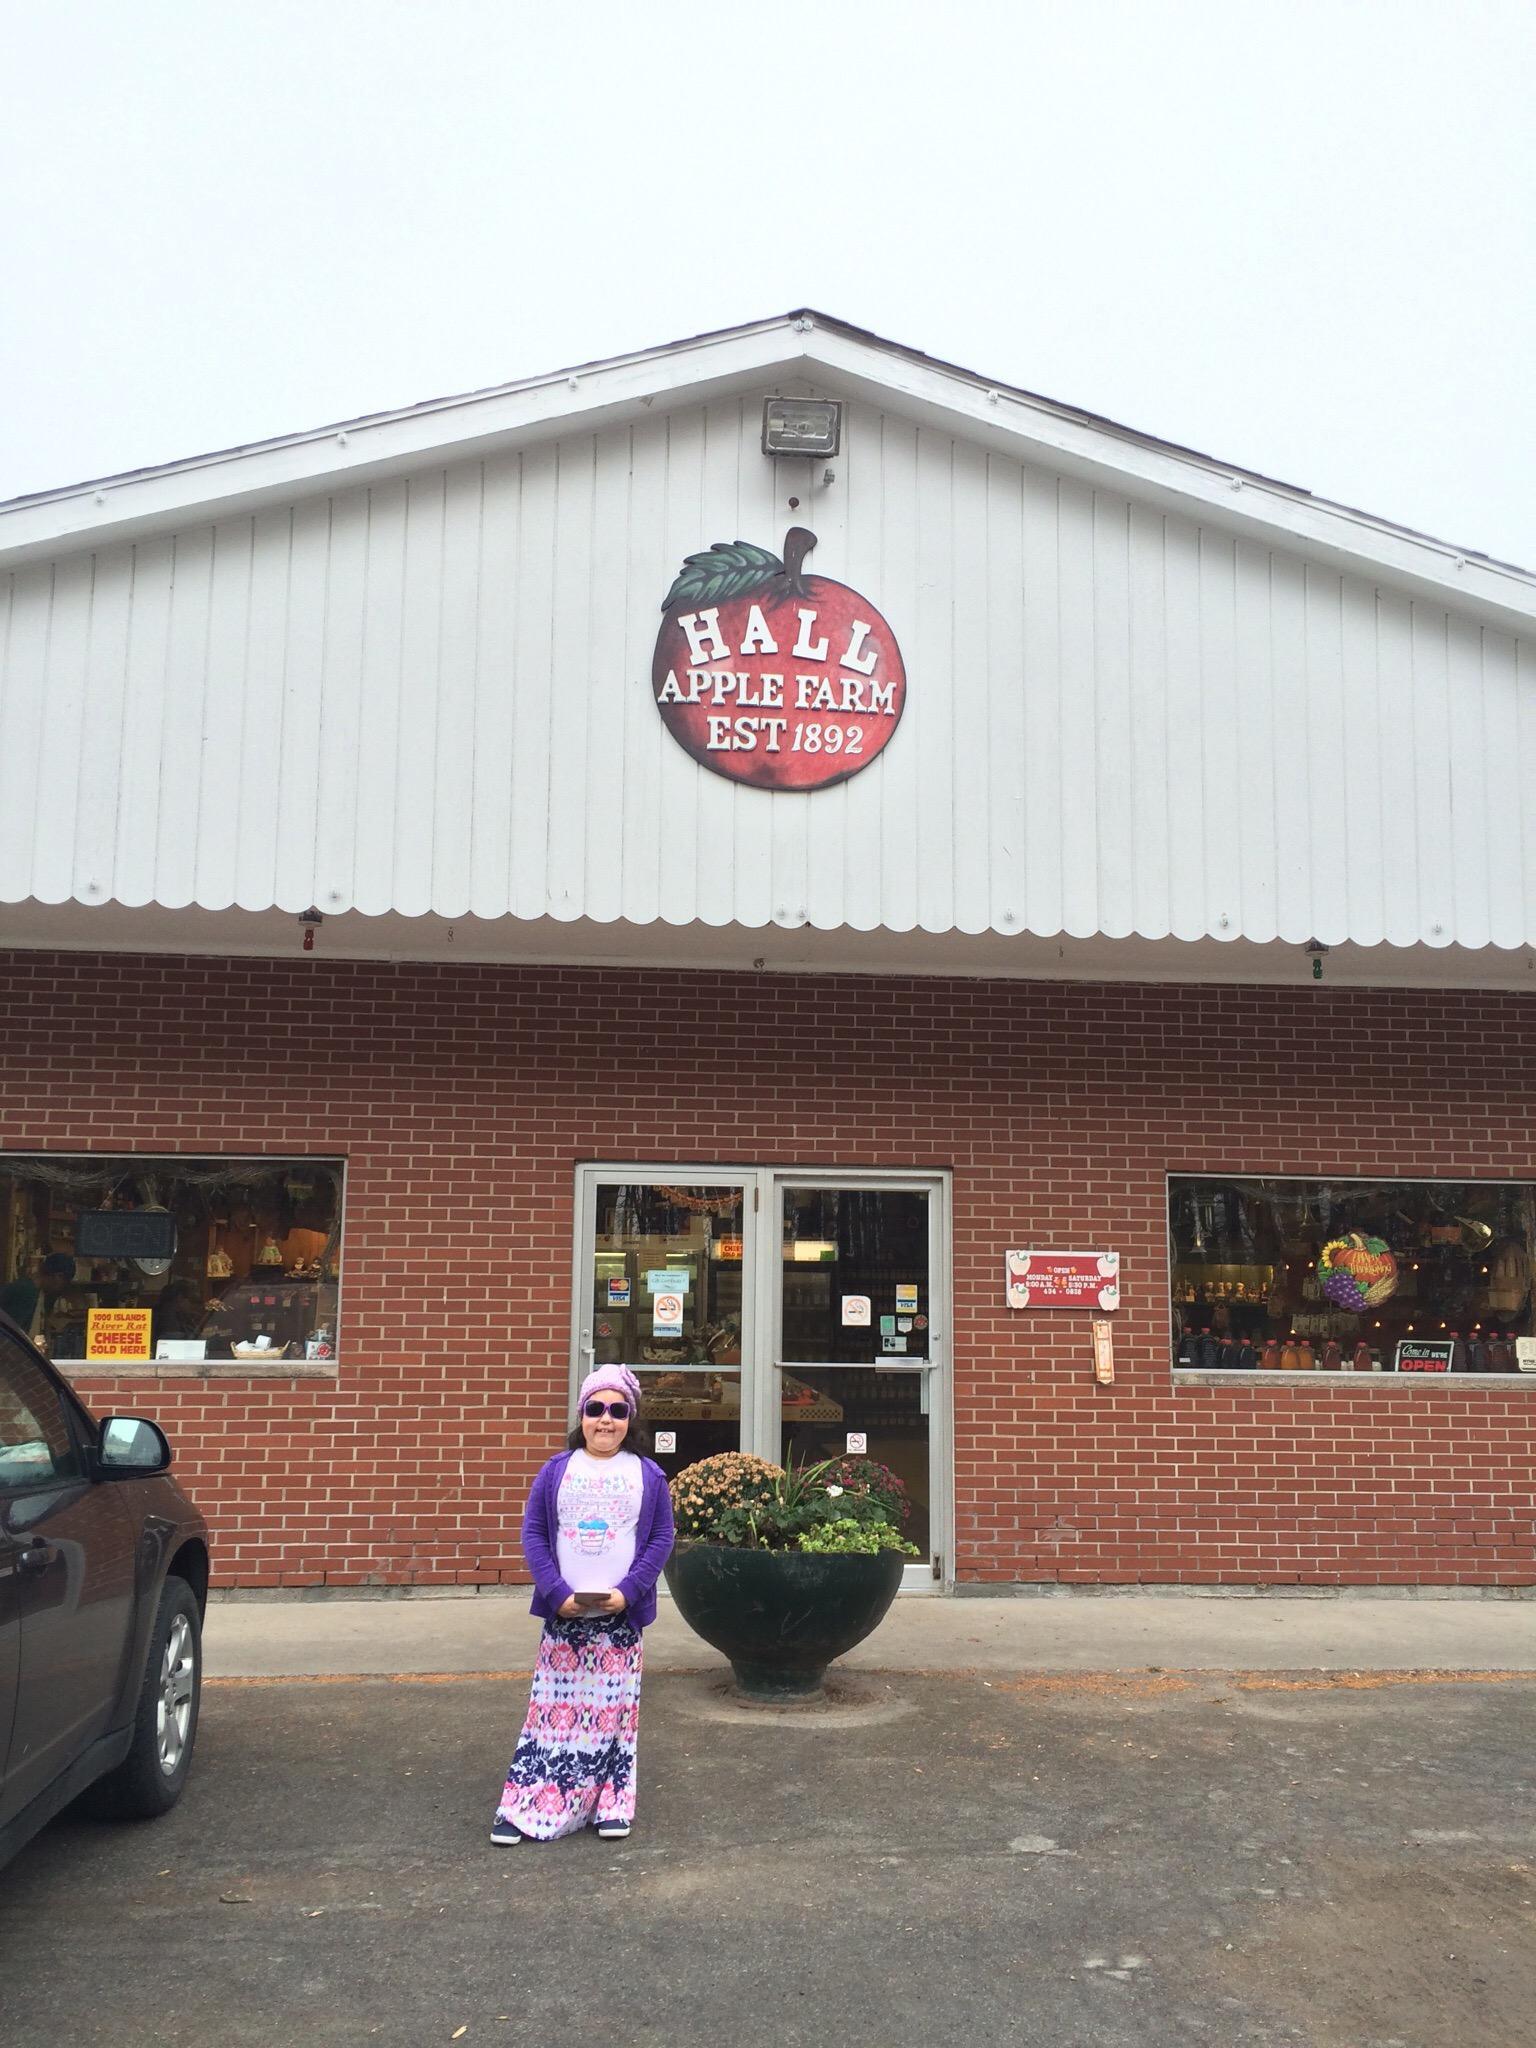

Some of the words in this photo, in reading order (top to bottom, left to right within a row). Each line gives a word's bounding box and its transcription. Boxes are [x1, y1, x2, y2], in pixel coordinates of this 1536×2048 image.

[677, 604, 878, 676] HALL
[657, 669, 784, 708] APPLE
[794, 673, 897, 716] FARM
[706, 716, 787, 752] EST
[791, 723, 864, 755] 1892
[1053, 1266, 1071, 1274] OPEN
[94, 1313, 112, 1321] 1000
[113, 1313, 147, 1322] ISLANDS
[91, 1321, 123, 1329] River
[126, 1321, 147, 1330] Rat
[94, 1332, 143, 1345] CHEESE
[90, 1345, 117, 1355] SOLD
[120, 1345, 147, 1355] HERE
[1402, 1344, 1422, 1356] Come
[1421, 1348, 1431, 1356] in
[1401, 1359, 1447, 1372] OPEN
